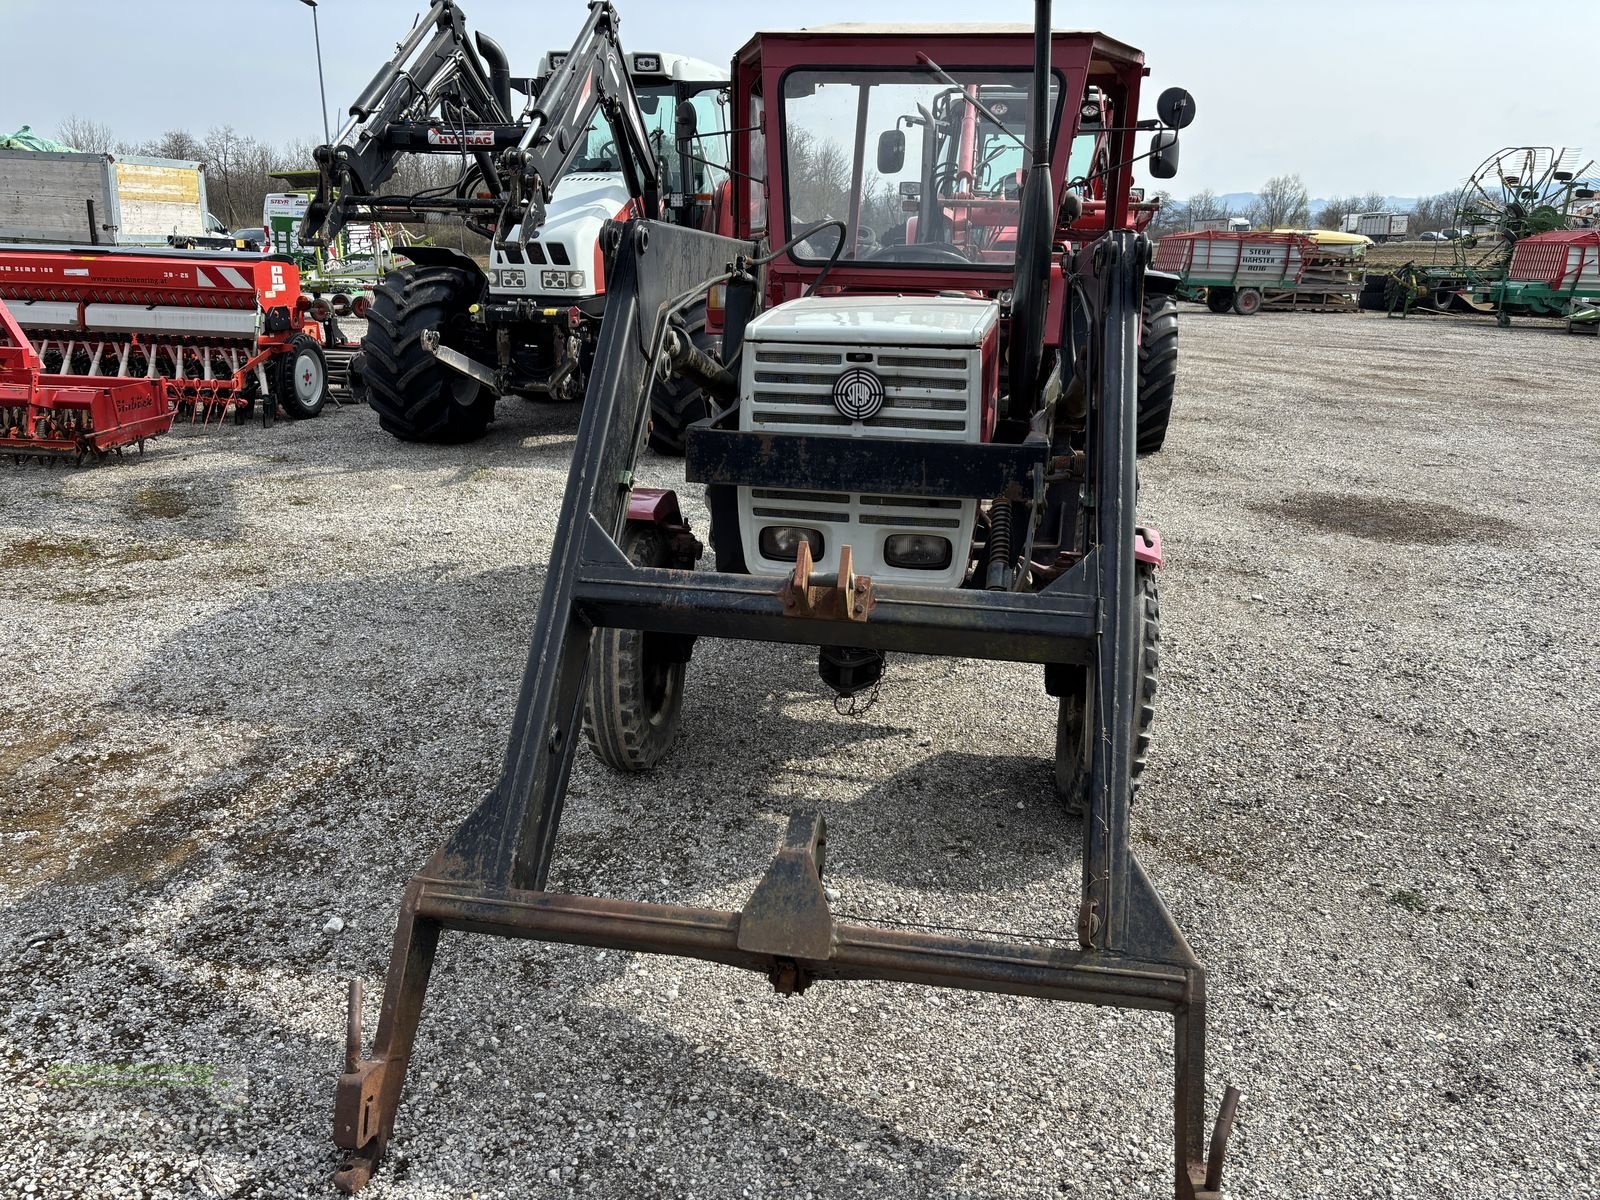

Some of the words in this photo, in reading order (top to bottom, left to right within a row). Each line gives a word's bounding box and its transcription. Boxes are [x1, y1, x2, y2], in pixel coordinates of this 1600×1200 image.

[1249, 248, 1271, 256] STEYR
[1242, 256, 1275, 264] HAMSTER
[91, 277, 168, 285] www.maschinenring.at
[847, 382, 870, 407] STEYR
